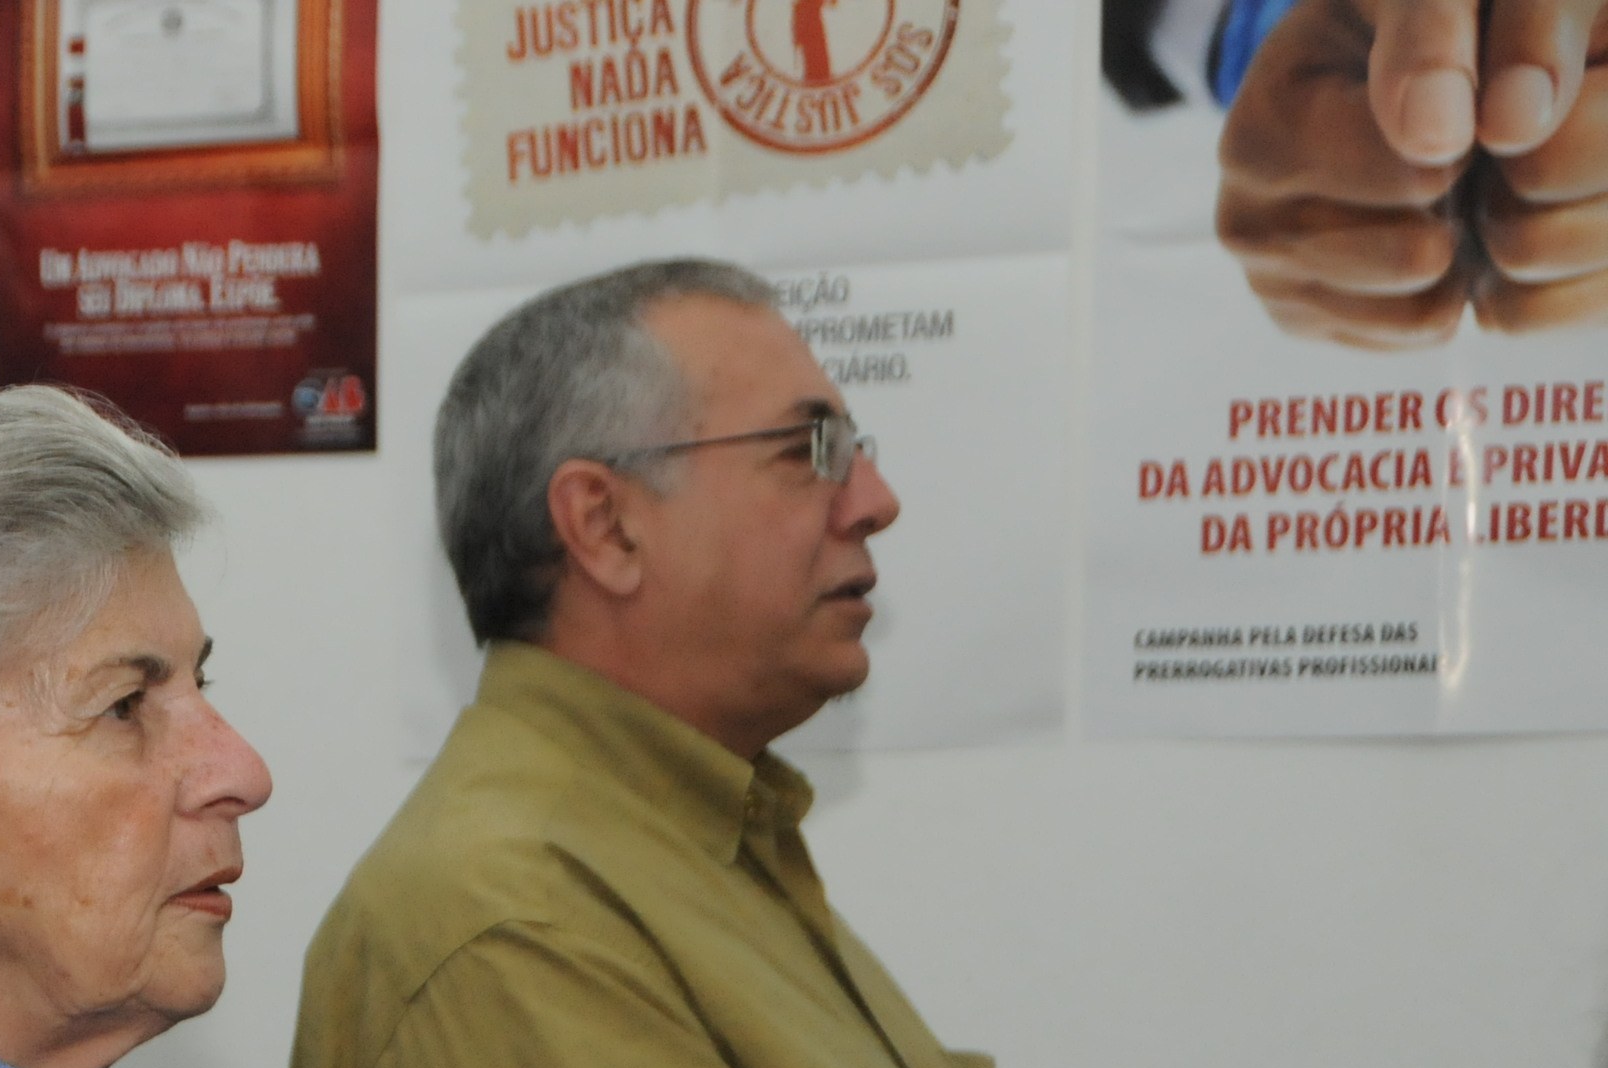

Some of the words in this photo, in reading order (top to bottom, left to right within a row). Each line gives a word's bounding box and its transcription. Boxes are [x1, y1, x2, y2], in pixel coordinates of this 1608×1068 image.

[506, 0, 676, 63] JUSTIÇA
[569, 46, 681, 112] NADA
[506, 102, 710, 186] FUNCIONA
[1228, 389, 1424, 440] PRENDER
[1502, 379, 1605, 427] DIRE
[1138, 458, 1190, 501] DA
[1201, 447, 1433, 499] ADVOCACIA
[1483, 437, 1608, 486] PRIVA
[1199, 513, 1253, 556] DA
[1265, 500, 1452, 552] PRÓPRIA
[1134, 624, 1244, 650] CAMPANHA
[1248, 624, 1297, 647] PELA
[1301, 623, 1377, 647] DEFESA
[1380, 621, 1419, 644] DAS
[1133, 657, 1293, 682] PRERROGATIVAS
[1297, 652, 1444, 679] PROFISSIONAI
